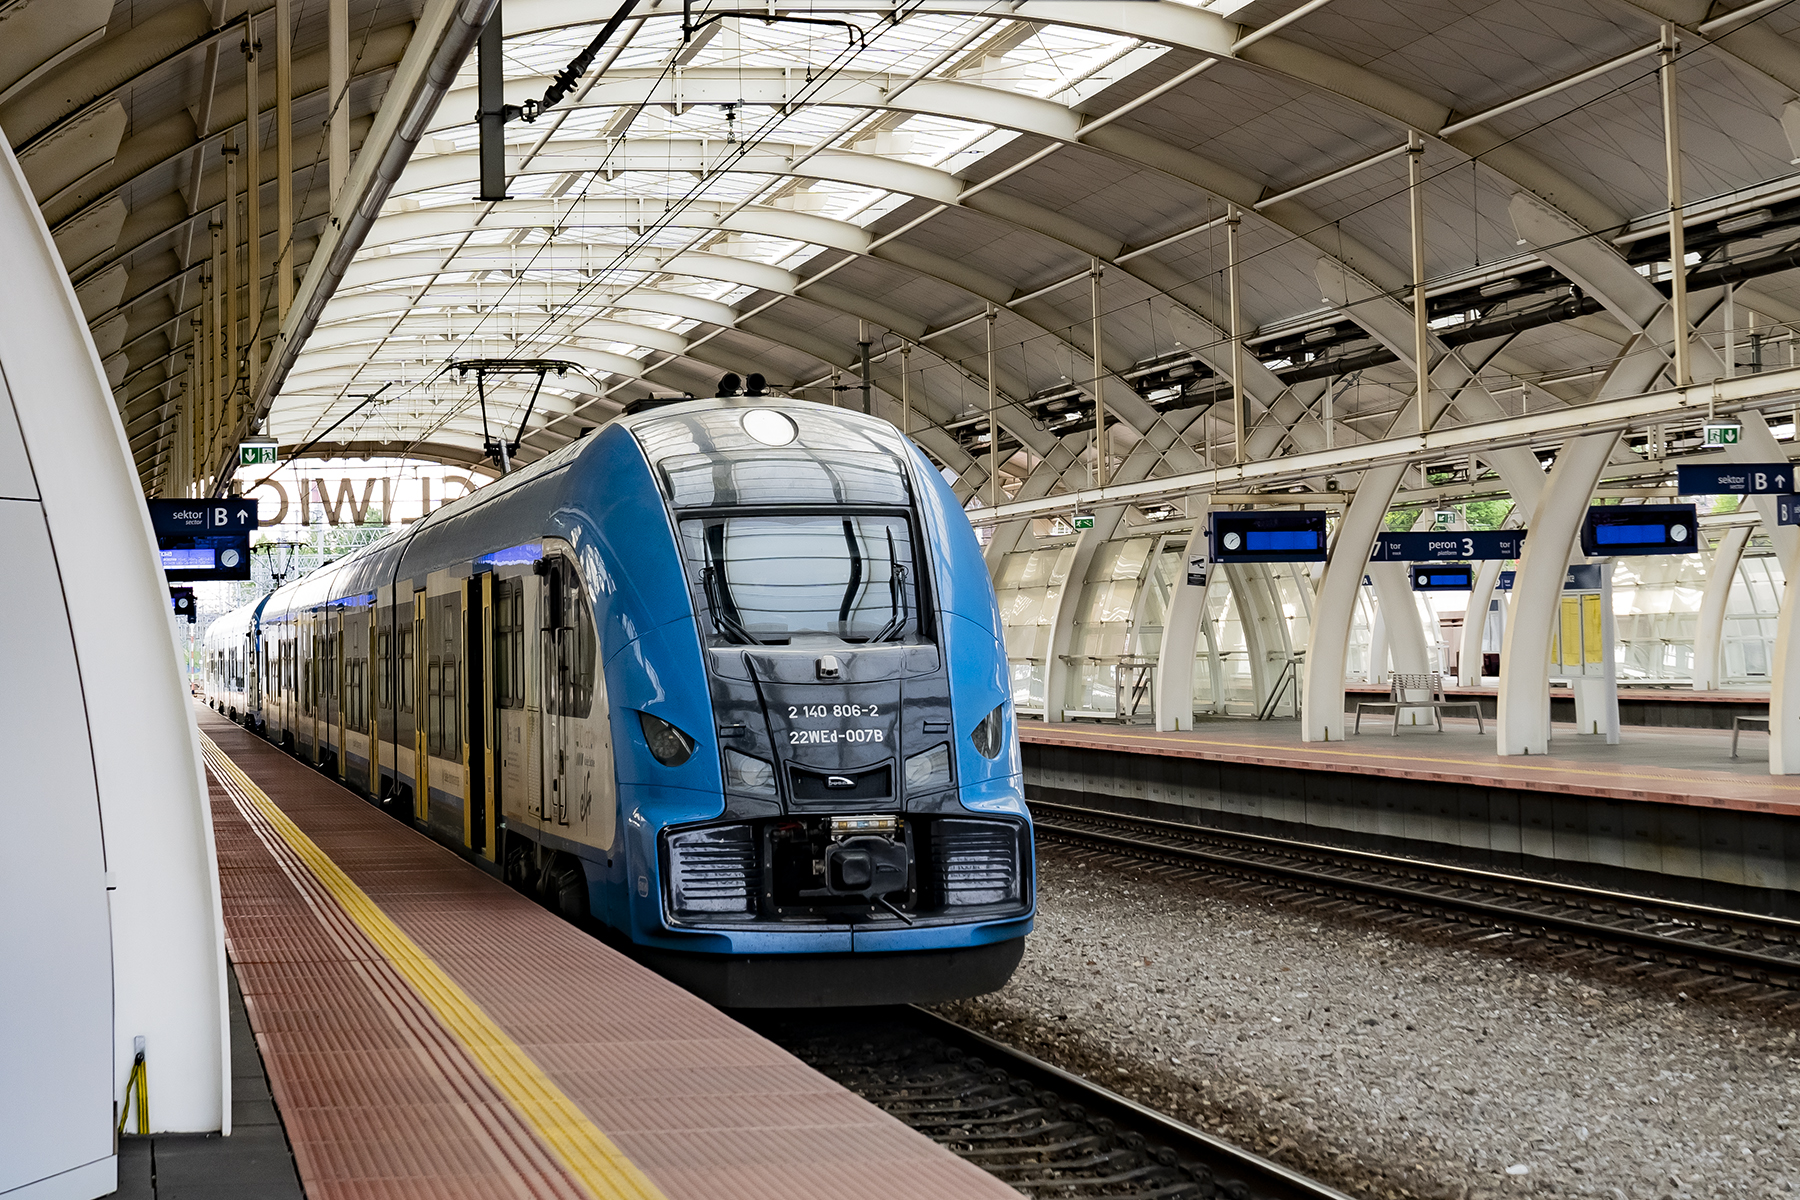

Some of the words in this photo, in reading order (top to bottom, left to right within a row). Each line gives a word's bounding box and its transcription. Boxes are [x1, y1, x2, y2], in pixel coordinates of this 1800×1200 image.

[1717, 475, 1745, 484] sektor
[1754, 473, 1768, 490] B
[172, 510, 203, 520] sektor
[214, 507, 228, 526] B
[1781, 504, 1788, 521] B
[1428, 540, 1457, 551] peron
[1461, 538, 1474, 557] 3
[1499, 541, 1511, 549] tor
[788, 706, 798, 719] 2
[803, 705, 827, 718] 140
[833, 704, 879, 717] 806-2
[789, 729, 884, 744] 22WEd-007B
